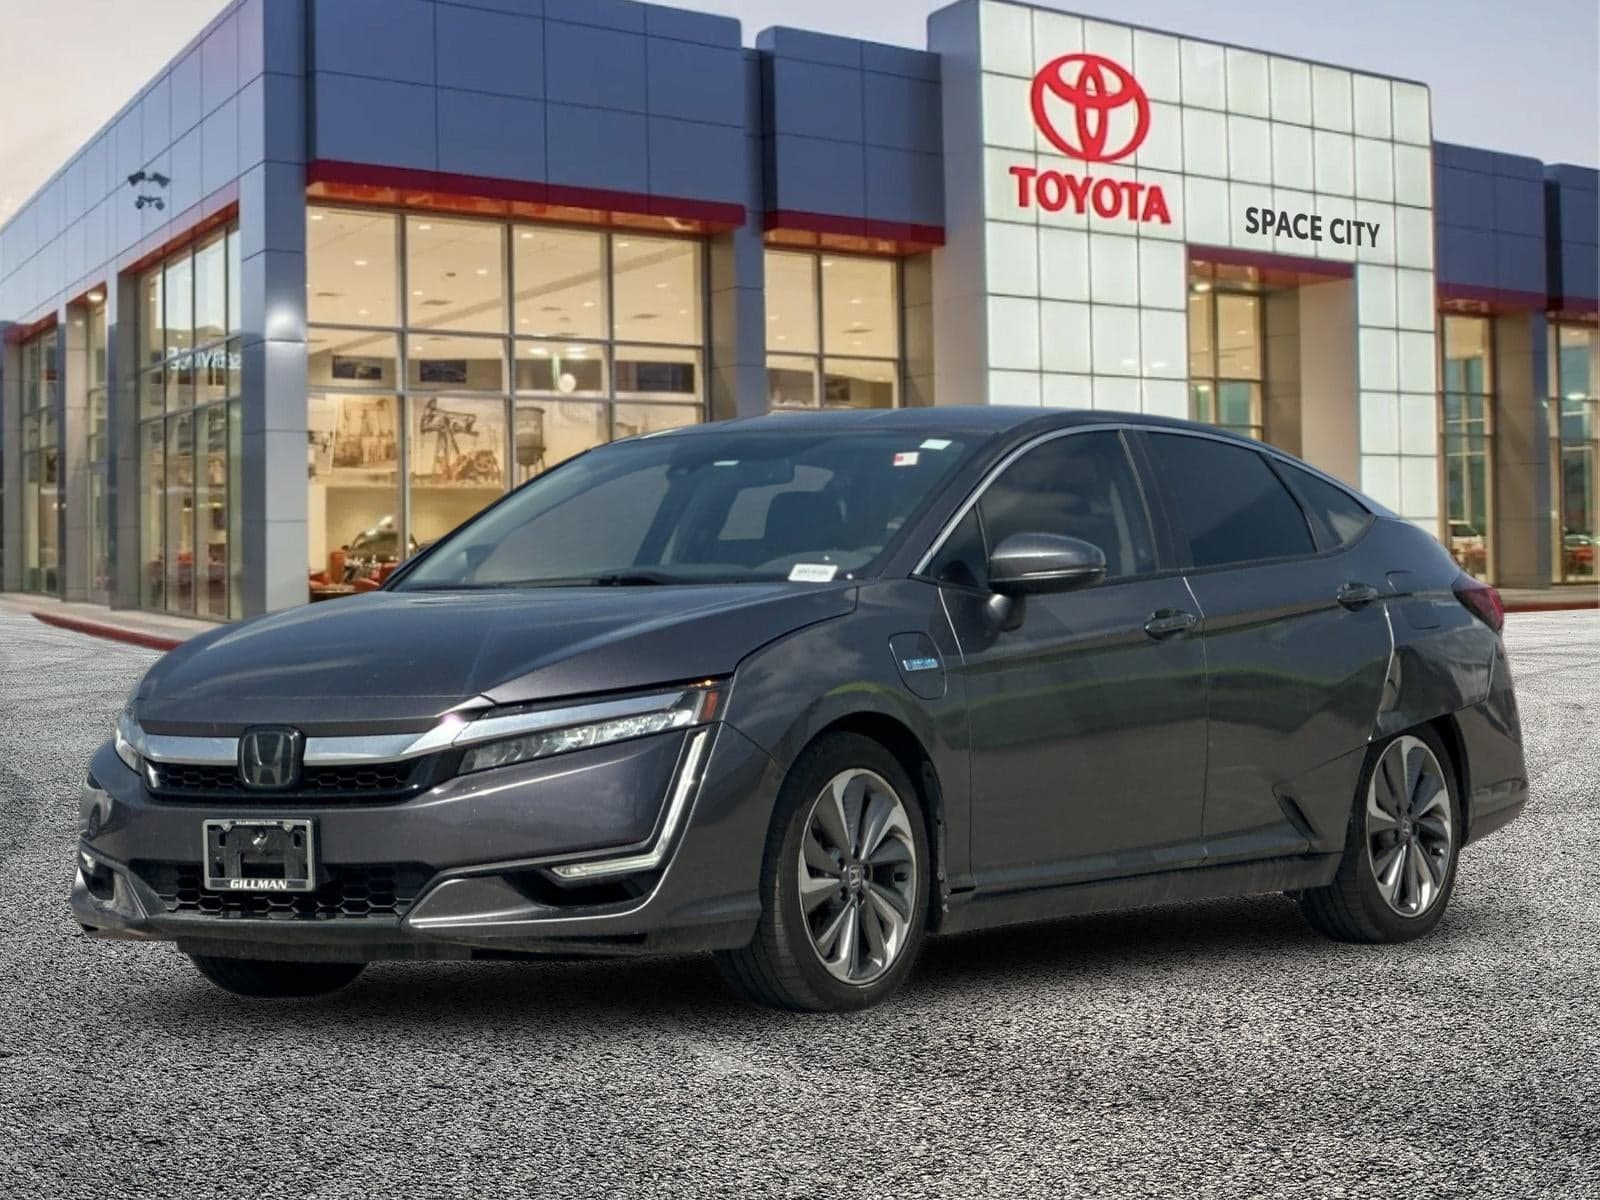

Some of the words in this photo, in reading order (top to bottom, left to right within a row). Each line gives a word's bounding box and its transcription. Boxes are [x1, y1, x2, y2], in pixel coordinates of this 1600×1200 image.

[1009, 165, 1171, 225] TOYOTA
[1245, 206, 1322, 242] SPACE
[1329, 218, 1380, 248] CITY
[230, 879, 288, 889] GILLMAN
